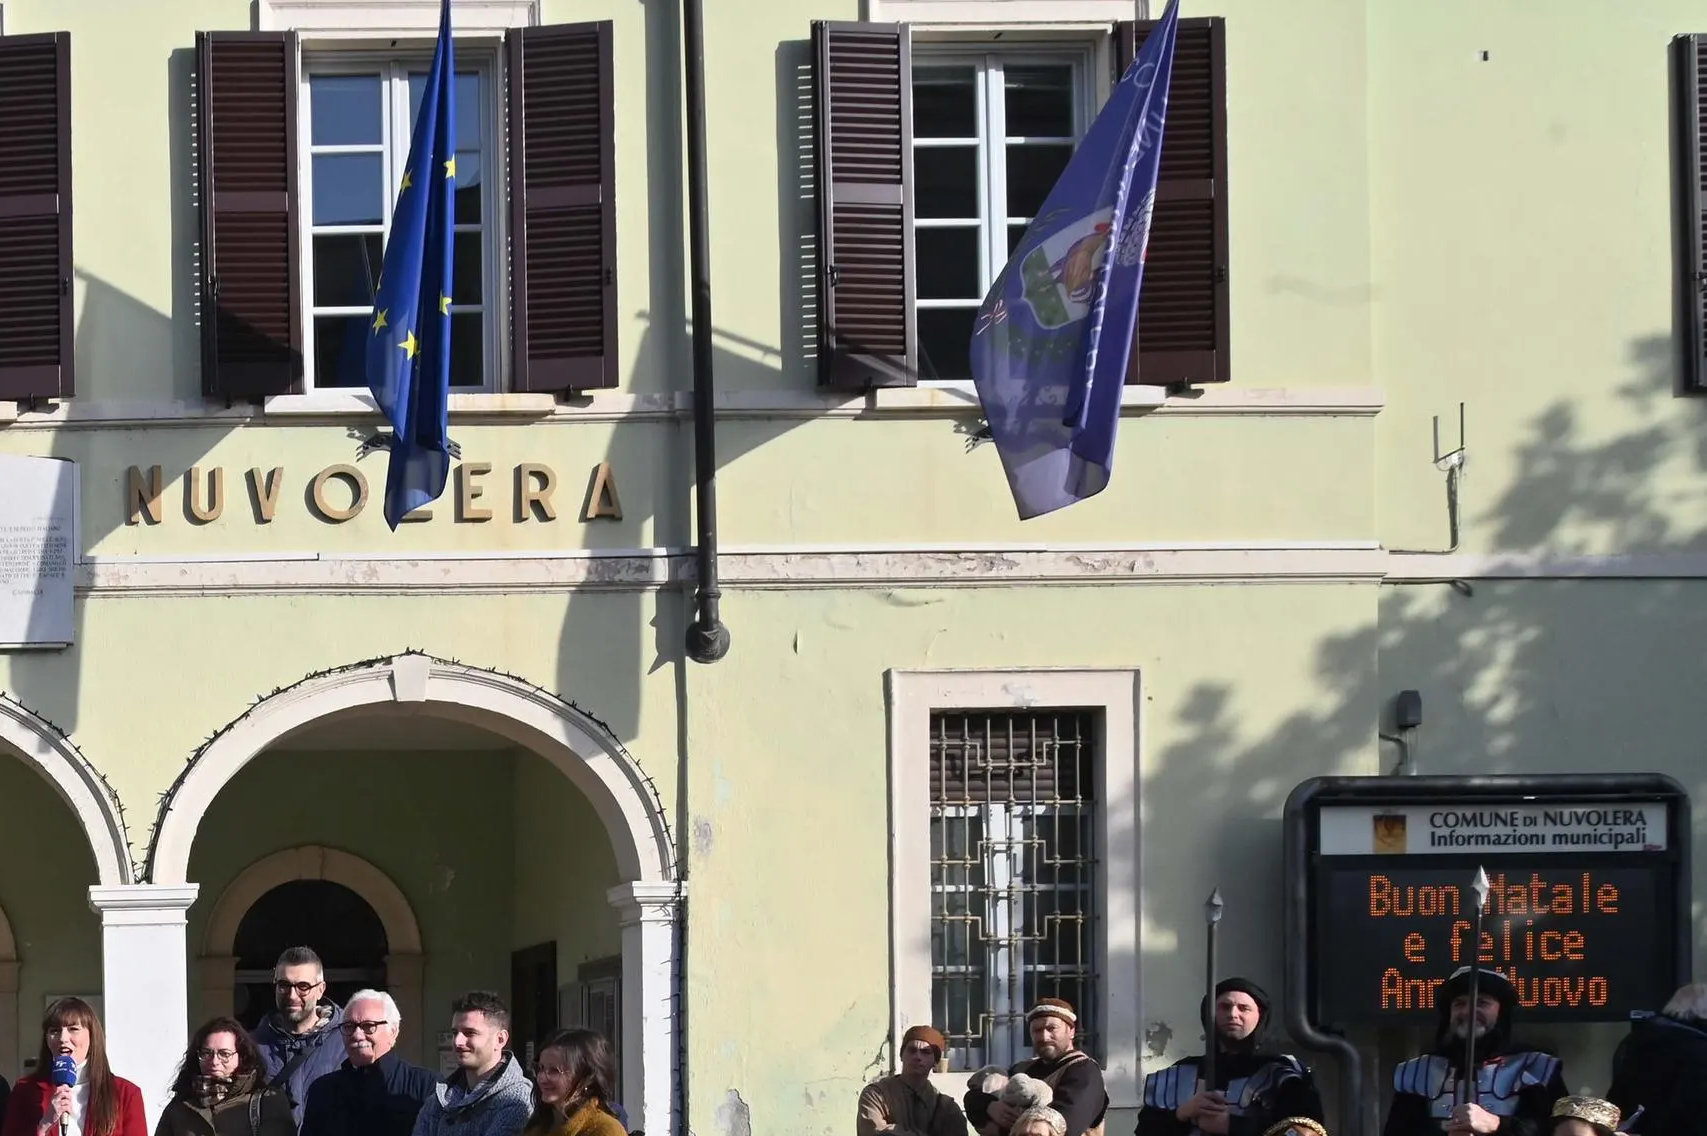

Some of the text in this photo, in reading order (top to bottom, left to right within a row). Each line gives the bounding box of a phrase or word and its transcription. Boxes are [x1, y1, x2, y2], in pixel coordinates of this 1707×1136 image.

[124, 463, 623, 526] NUVOERA
[1429, 811, 1519, 828] COMUNE
[1543, 810, 1647, 827] NUVOLERA
[1430, 827, 1647, 849] Informazioni municipali
[1369, 872, 1620, 916] Buon Natale
[1404, 919, 1585, 962] e felice
